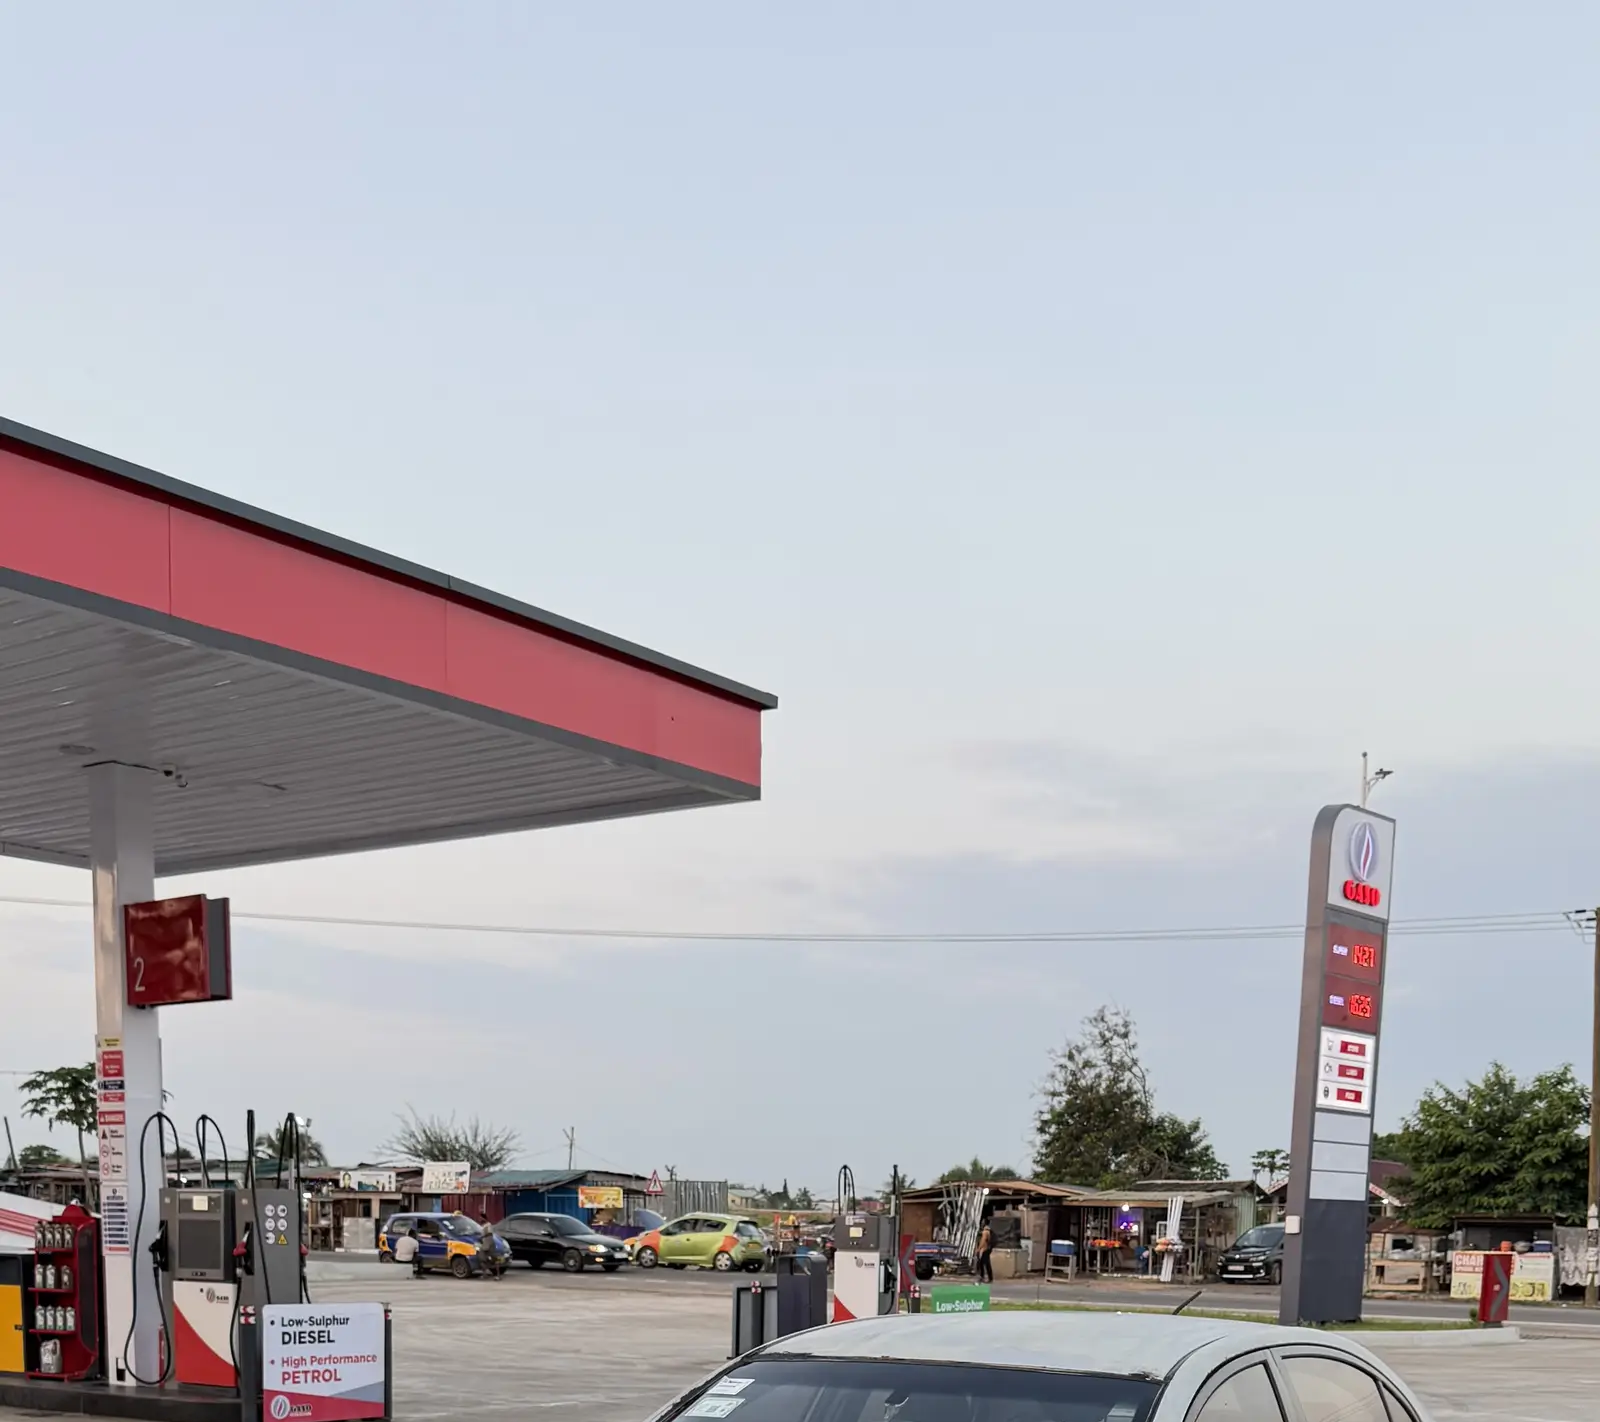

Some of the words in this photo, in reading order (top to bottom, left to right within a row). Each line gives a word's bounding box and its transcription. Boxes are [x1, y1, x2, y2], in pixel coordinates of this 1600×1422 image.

[134, 957, 146, 991] 2
[936, 1299, 984, 1312] Low-Sulphur
[281, 1315, 350, 1328] Low-Sulphur
[281, 1330, 336, 1345] DIESEL
[281, 1356, 307, 1369] High
[310, 1354, 377, 1366] Performance
[281, 1368, 342, 1385] PETROL
